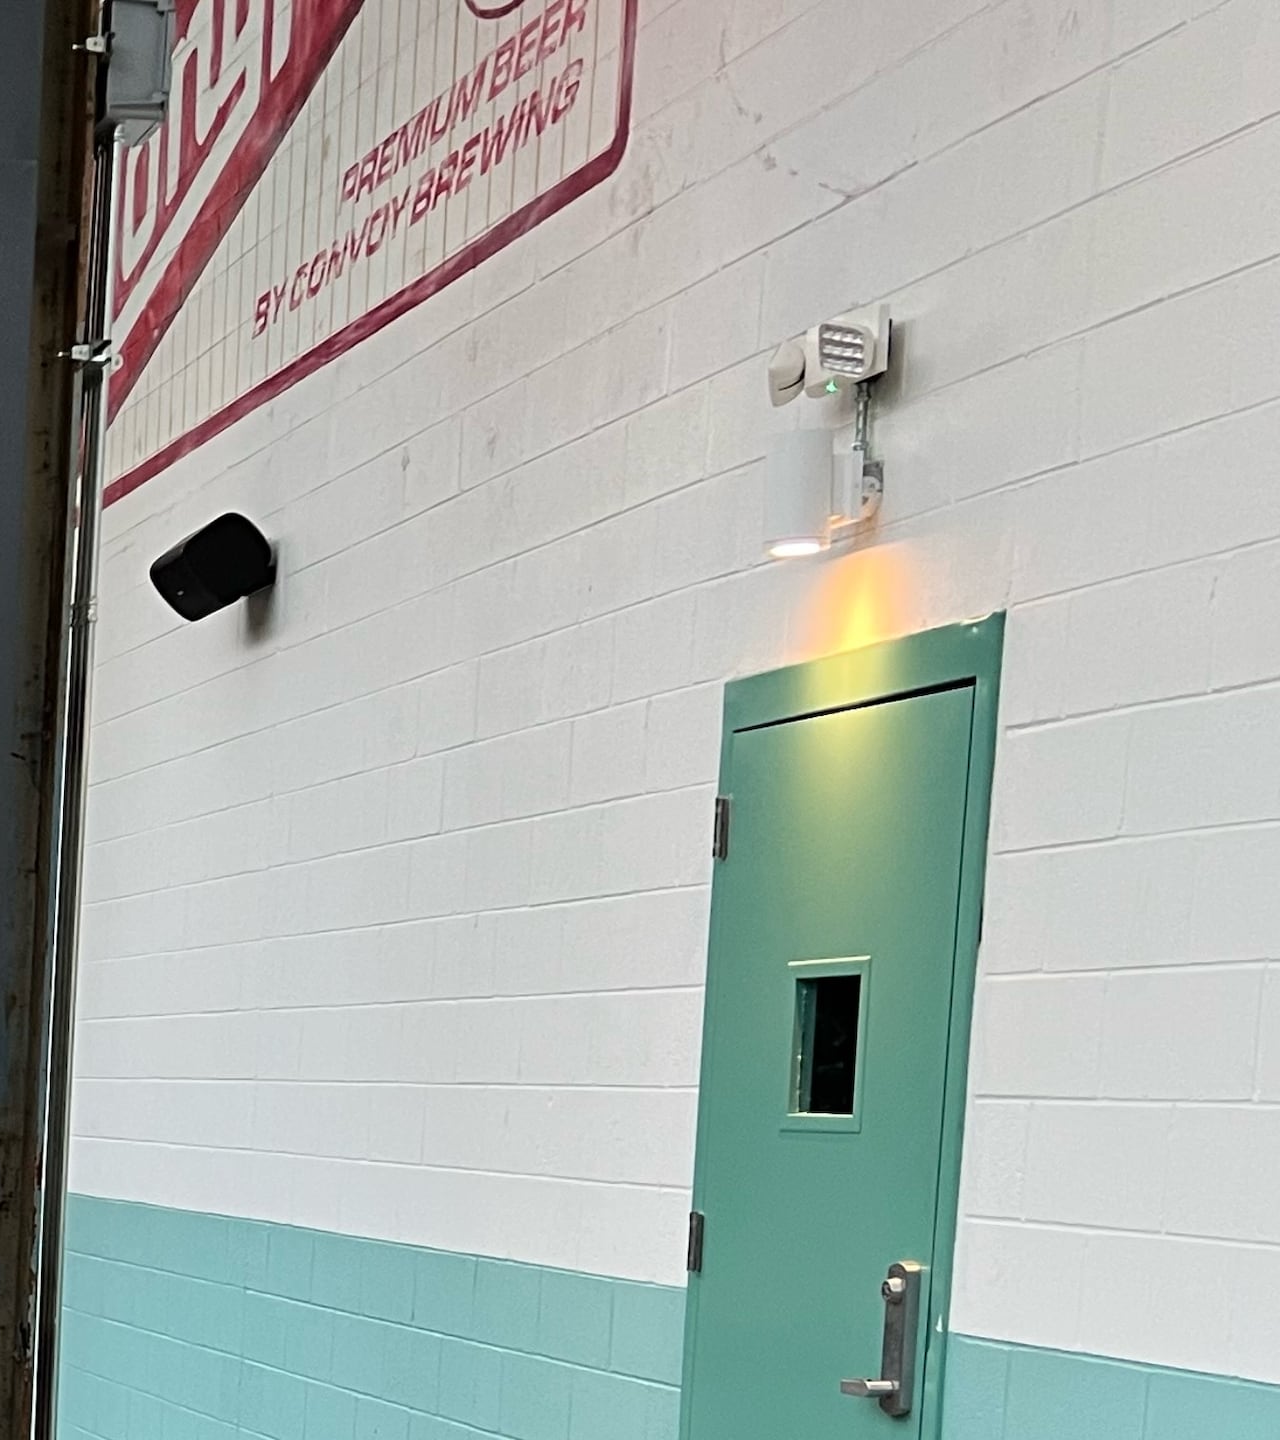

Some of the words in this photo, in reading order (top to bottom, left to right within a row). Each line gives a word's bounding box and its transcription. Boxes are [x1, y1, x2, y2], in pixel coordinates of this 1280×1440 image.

[251, 277, 288, 340] BY
[289, 185, 411, 313] CONVOY
[409, 57, 584, 228] BREWING
[342, 55, 489, 203] PREMIUM
[487, 0, 588, 102] BEER
